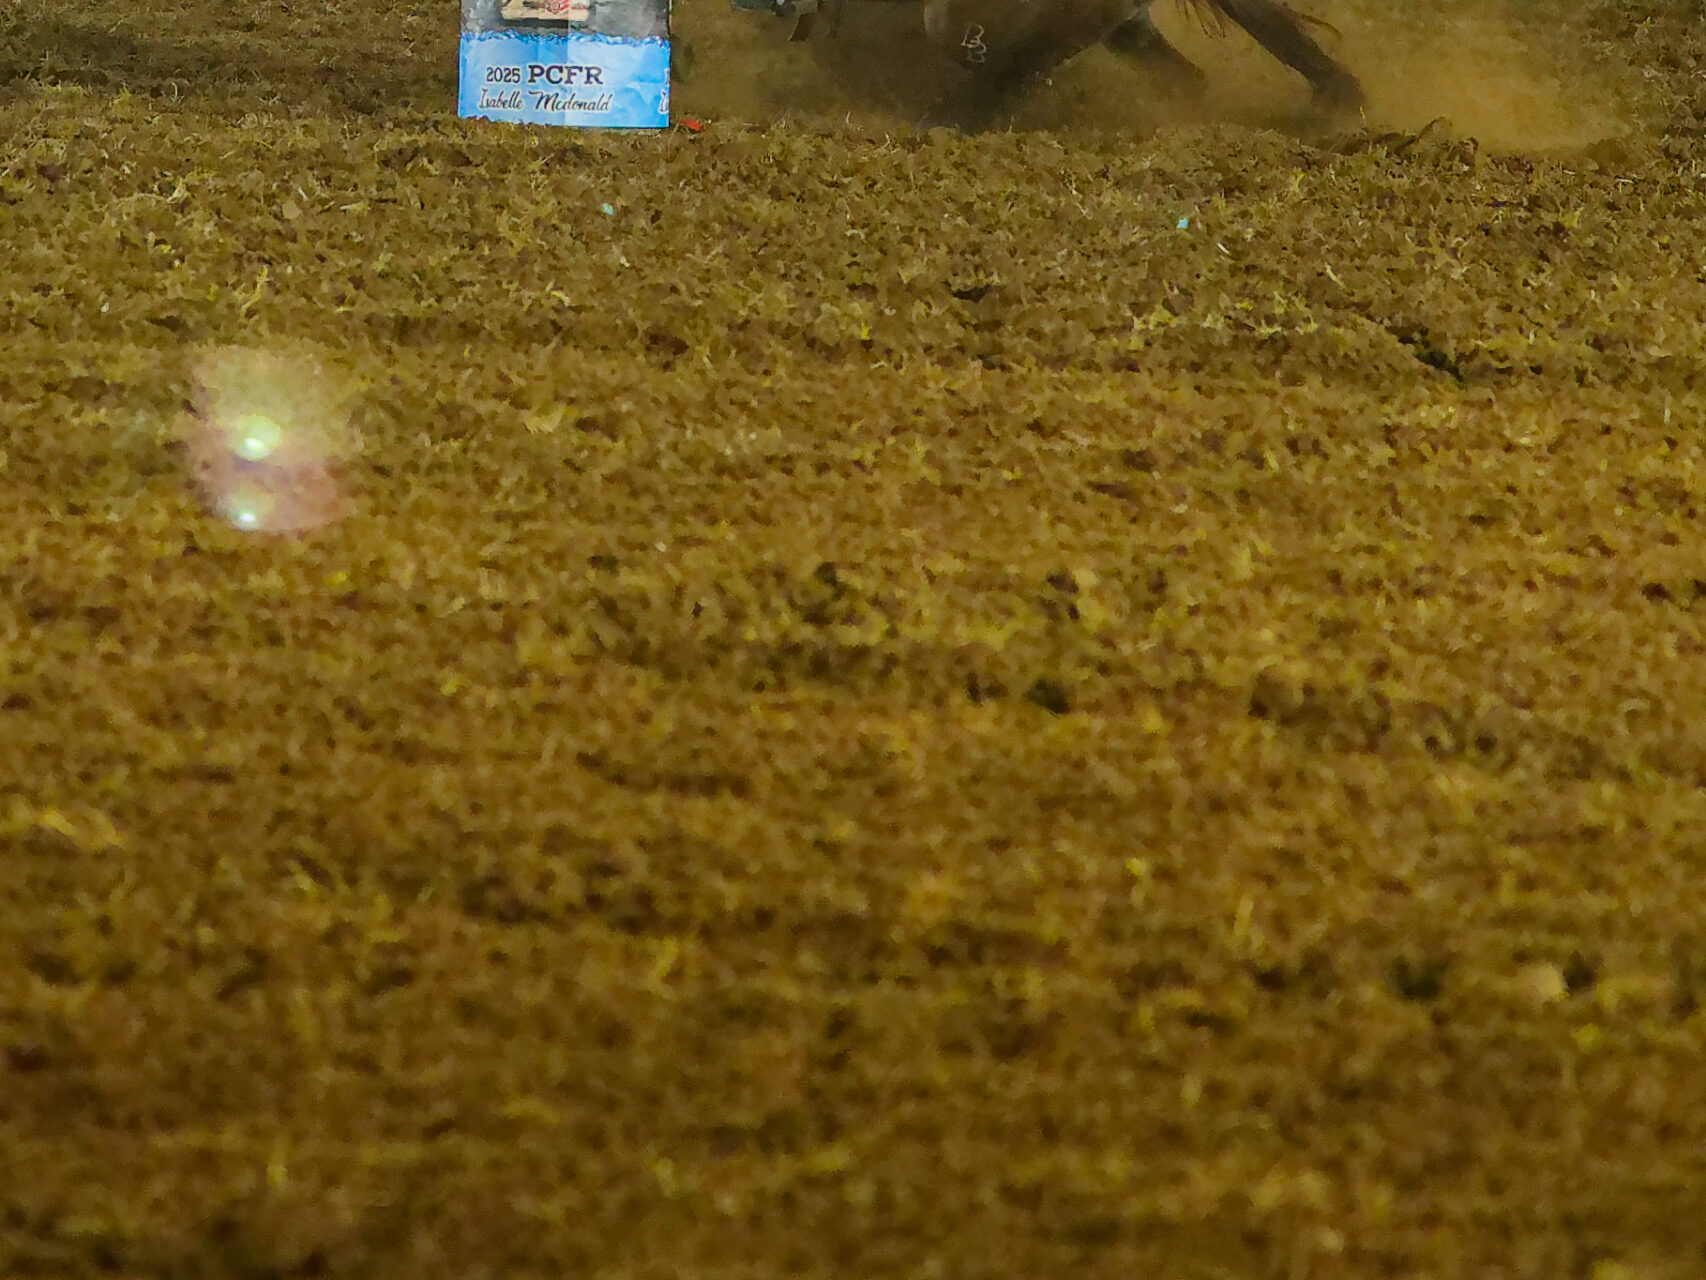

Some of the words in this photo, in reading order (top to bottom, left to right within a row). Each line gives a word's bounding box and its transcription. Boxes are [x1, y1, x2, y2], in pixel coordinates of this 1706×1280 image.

[486, 67, 521, 83] 2025
[527, 64, 604, 85] PCFR
[479, 88, 523, 111] Isabelle
